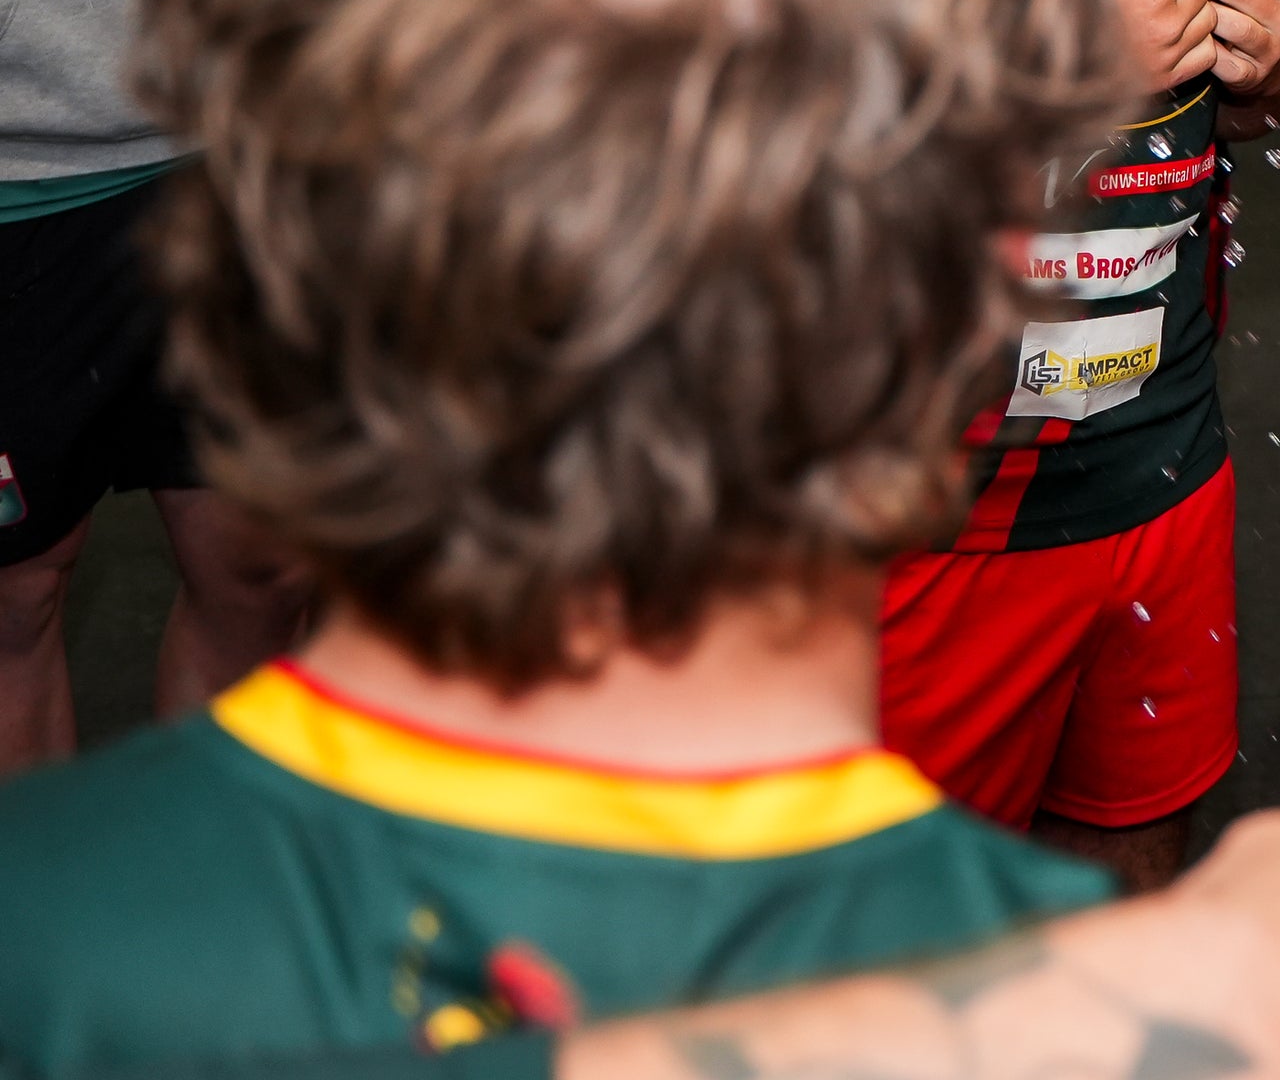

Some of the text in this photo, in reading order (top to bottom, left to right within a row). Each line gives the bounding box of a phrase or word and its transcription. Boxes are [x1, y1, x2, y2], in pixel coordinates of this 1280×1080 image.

[1100, 174, 1132, 190] CNW
[1137, 167, 1189, 187] Electrical
[1023, 259, 1067, 279] AMS
[1077, 252, 1136, 279] BROS
[1078, 348, 1153, 377] IMPACT
